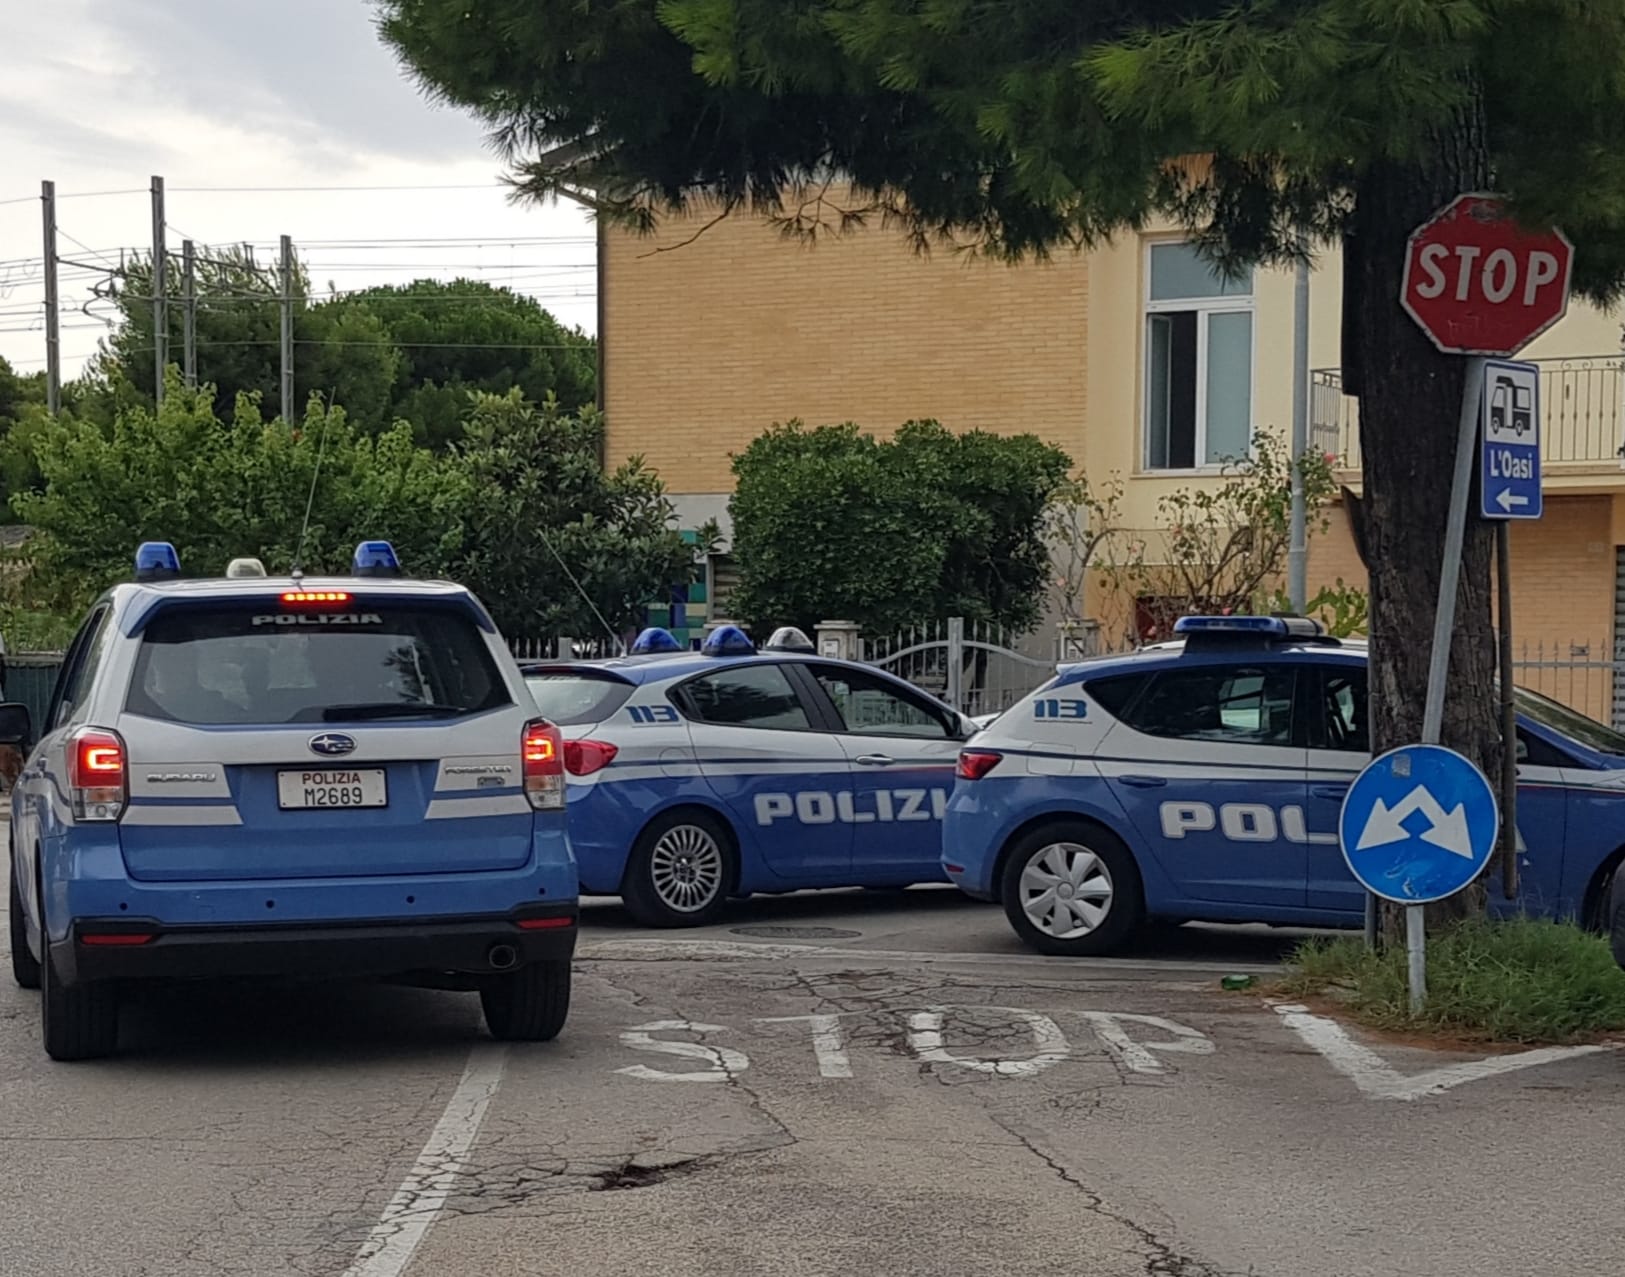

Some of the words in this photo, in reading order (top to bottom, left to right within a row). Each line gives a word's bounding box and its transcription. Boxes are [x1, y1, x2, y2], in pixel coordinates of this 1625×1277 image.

[1416, 243, 1558, 305] STOP
[1490, 449, 1533, 479] L'Oasi
[251, 613, 383, 625] POLIZIA
[625, 705, 679, 723] 113
[1033, 699, 1087, 719] 113
[302, 772, 361, 785] POLIZIA
[304, 787, 363, 805] M2689
[611, 1005, 1216, 1083] STOP
